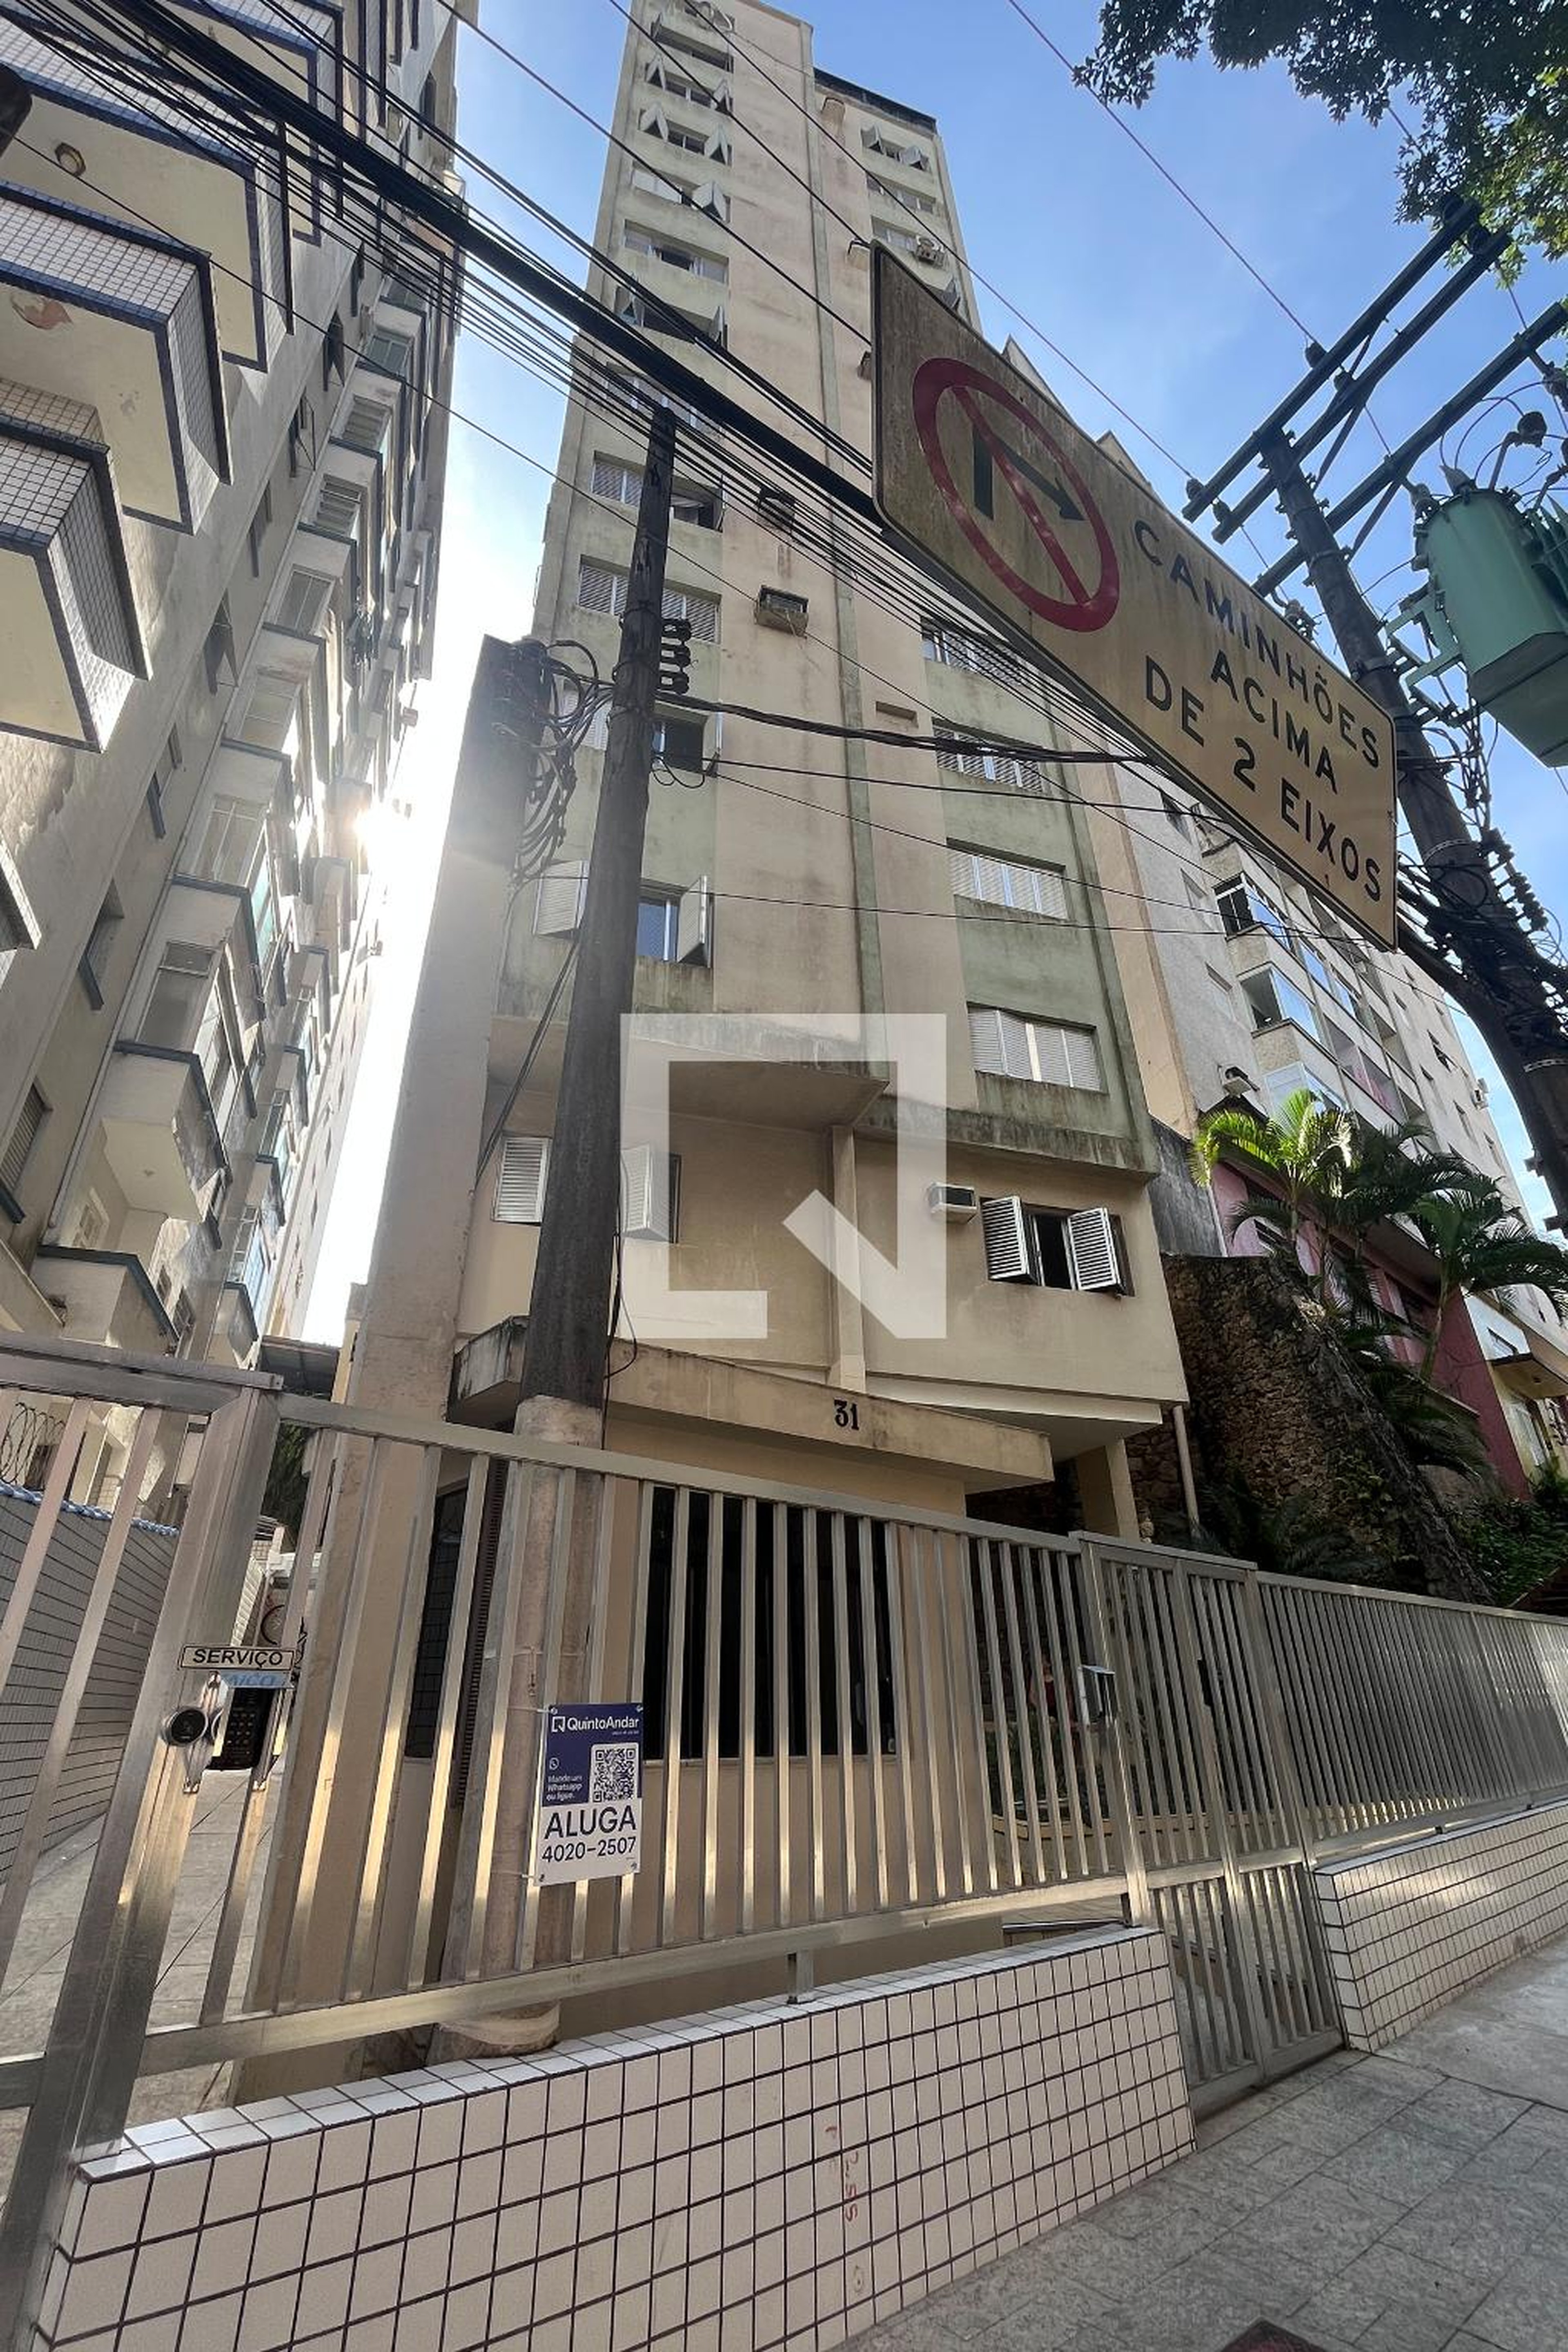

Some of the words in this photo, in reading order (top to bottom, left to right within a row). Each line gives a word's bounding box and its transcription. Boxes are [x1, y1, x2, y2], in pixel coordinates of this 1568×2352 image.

[1134, 519, 1380, 769] CAMINHÕES
[1210, 649, 1339, 794] ACIMA
[1145, 655, 1204, 746] DE
[1233, 736, 1256, 793] 2
[1281, 777, 1381, 902] EIXOS
[834, 1399, 859, 1430] 31
[193, 1648, 283, 1667] SERVIÇO
[567, 1716, 639, 1731] QuintoAndar
[544, 1805, 636, 1839] ALUGA
[541, 1836, 636, 1863] 4020-2507
